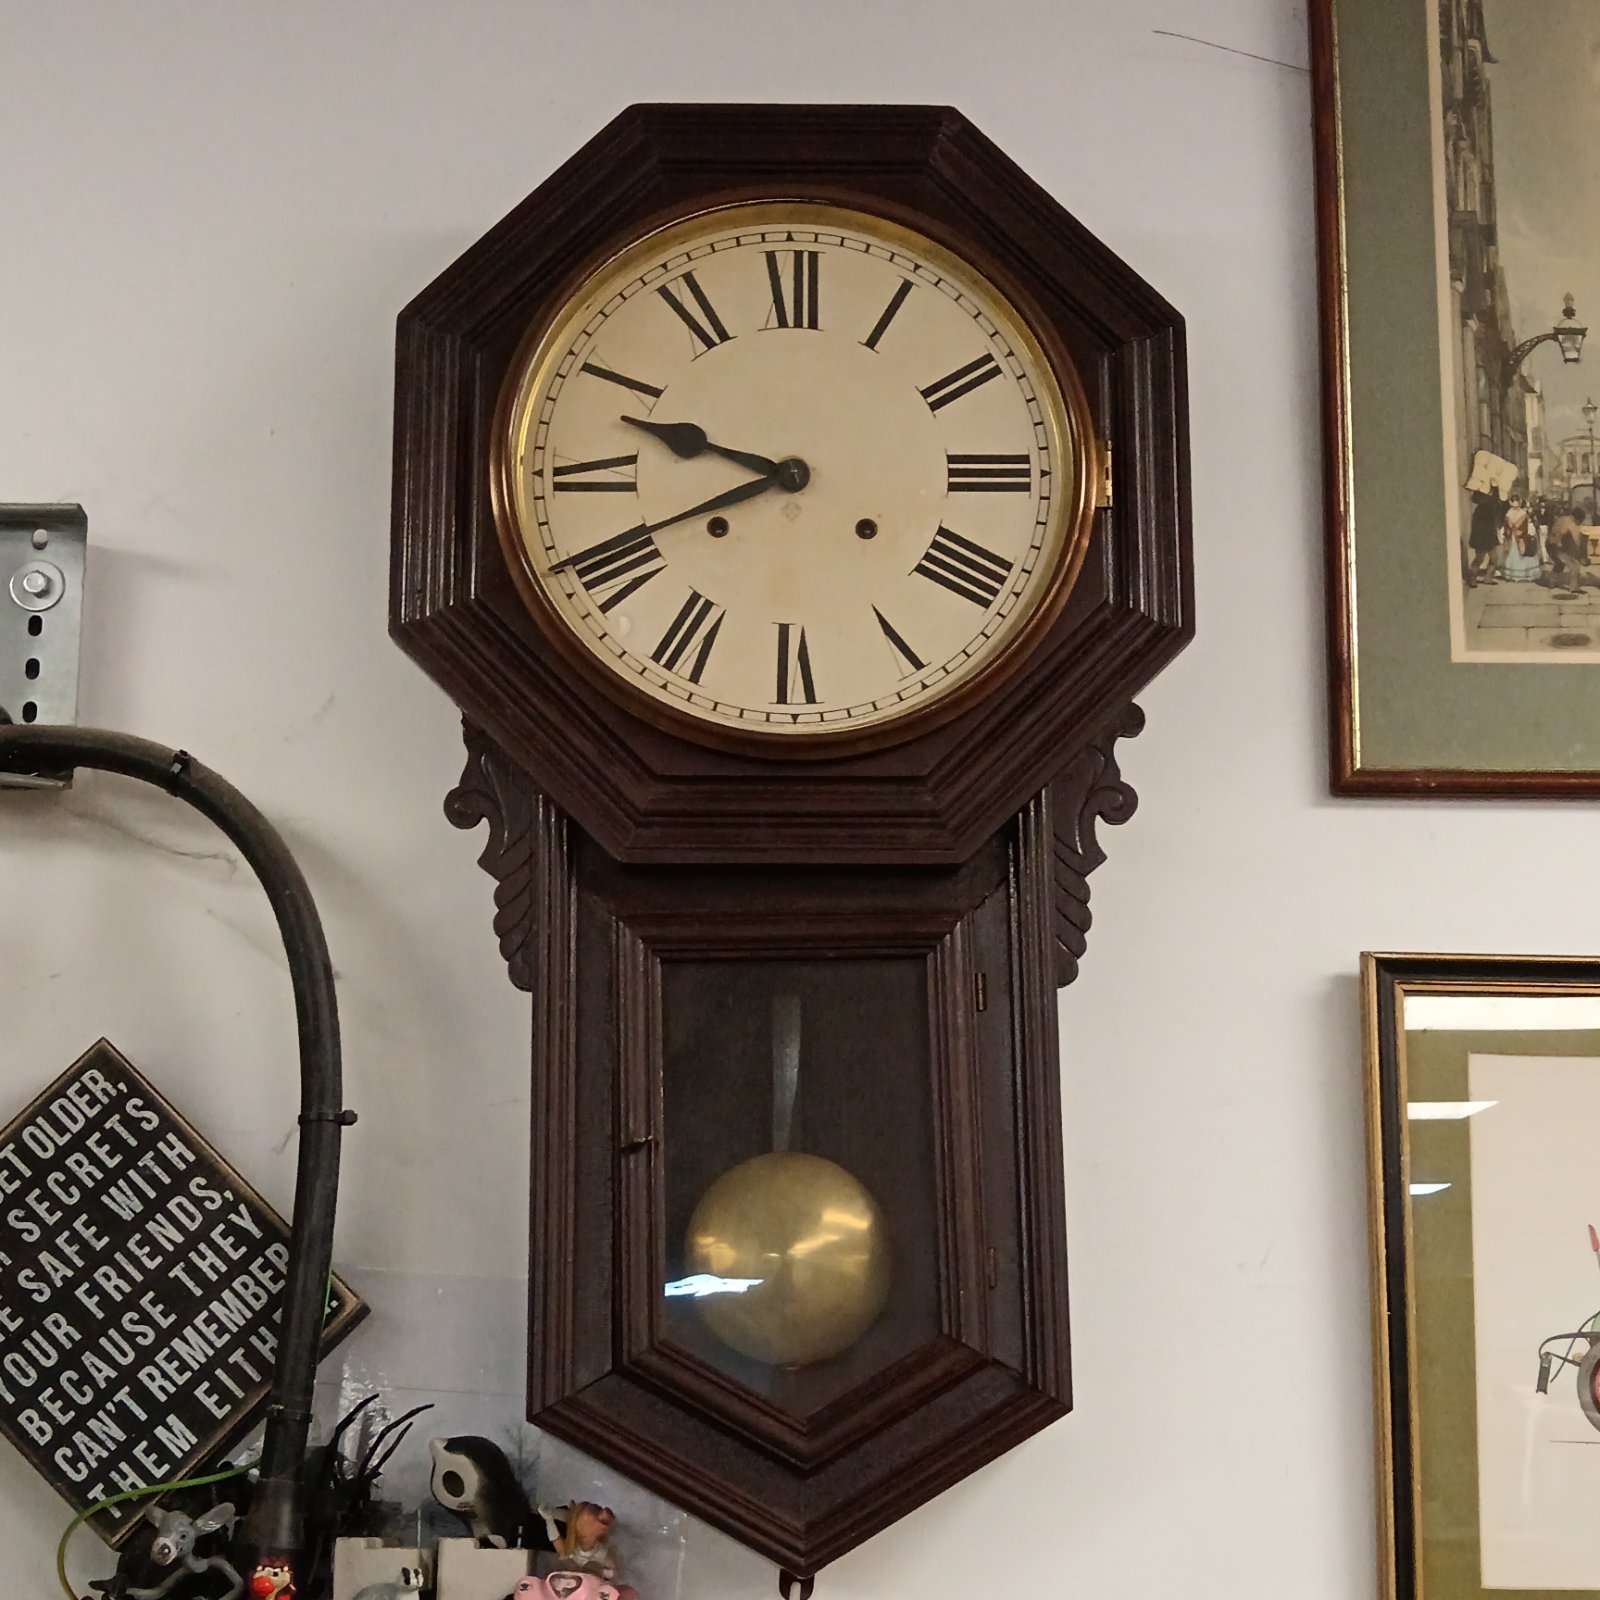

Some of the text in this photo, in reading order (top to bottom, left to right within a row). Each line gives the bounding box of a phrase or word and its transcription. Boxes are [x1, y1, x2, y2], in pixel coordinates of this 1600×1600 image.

[656, 269, 737, 362] XI
[758, 250, 825, 332] XII
[576, 344, 669, 417] X
[915, 348, 1003, 417] II
[553, 448, 640, 499] IX
[946, 449, 1031, 498] III
[651, 585, 727, 687] VII
[769, 621, 825, 704] VI
[870, 604, 932, 682] V
[0, 1069, 128, 1204] ET OLDER,
[7, 1097, 160, 1243] SECRETS
[17, 1213, 110, 1303] SAFE
[101, 1132, 196, 1221] WITH
[74, 1177, 234, 1320] FRIENDS,
[17, 1203, 263, 1447] BECAUSE THEY
[54, 1385, 148, 1482] CAN'T
[87, 1413, 199, 1519] THEM
